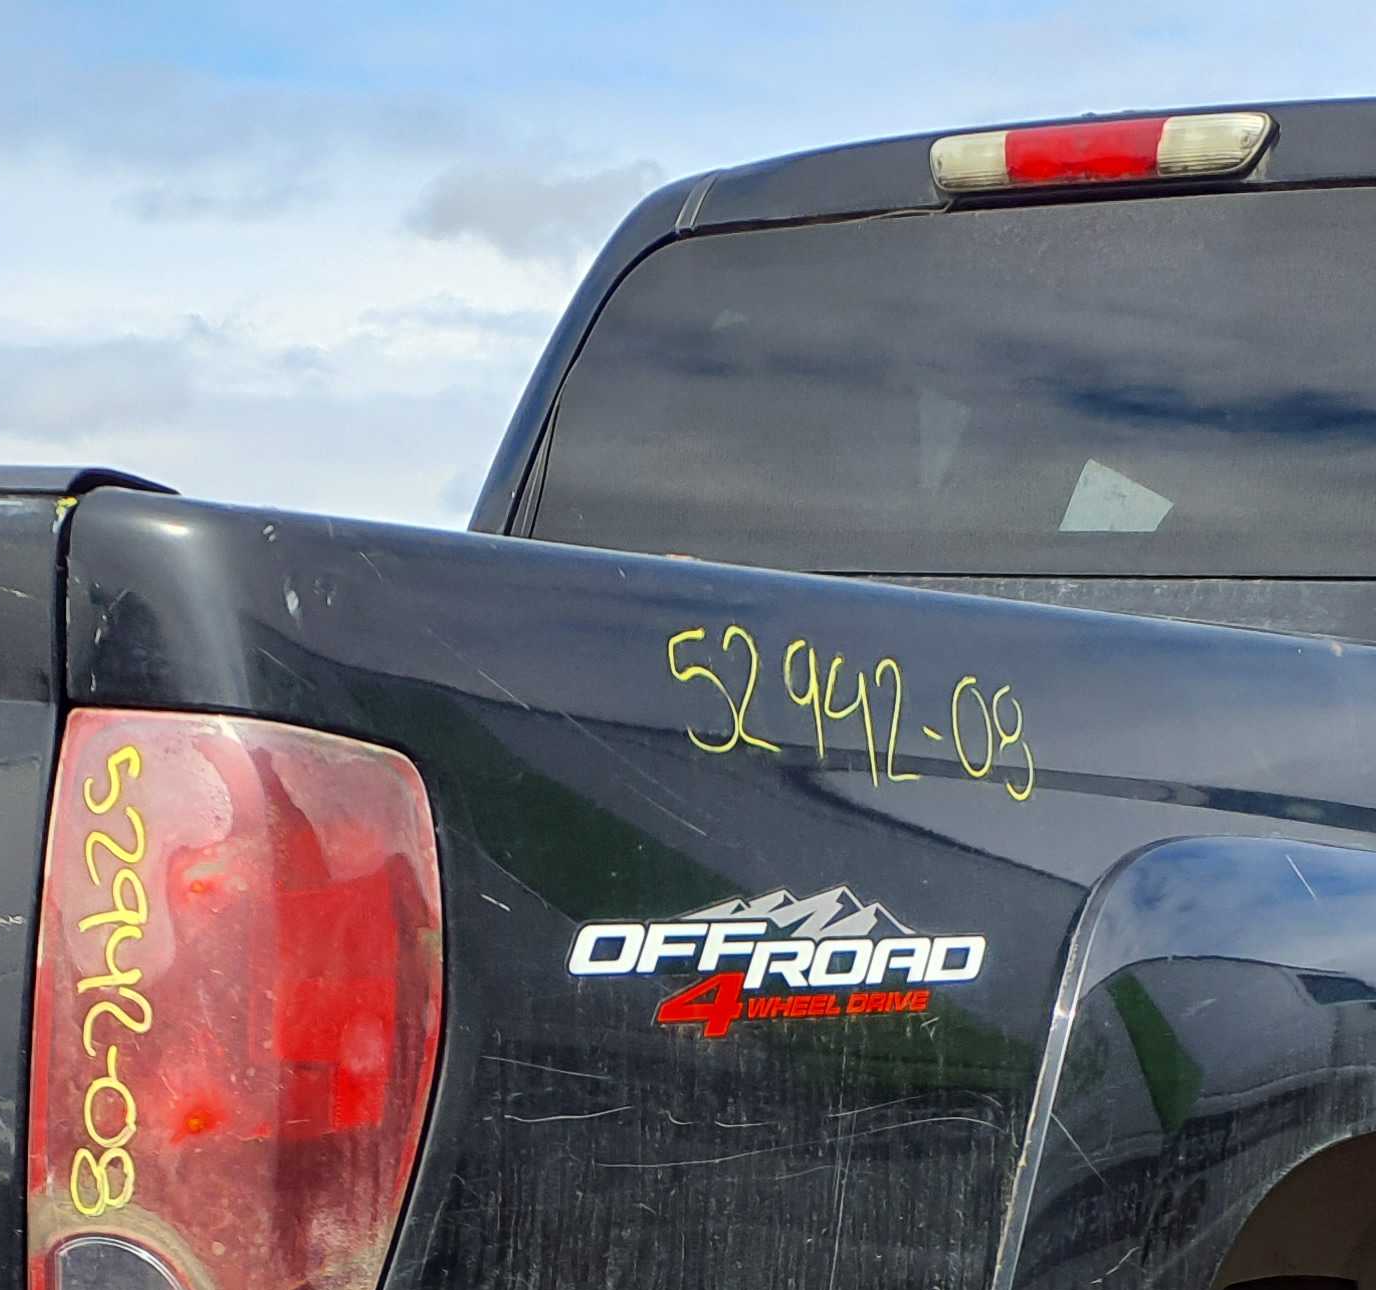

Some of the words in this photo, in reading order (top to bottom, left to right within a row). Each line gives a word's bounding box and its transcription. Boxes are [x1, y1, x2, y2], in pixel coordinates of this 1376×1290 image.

[70, 745, 154, 1217] 52942-08
[655, 971, 746, 1038] 4
[747, 992, 841, 1020] WHEEL
[846, 989, 930, 1015] DRIVE
